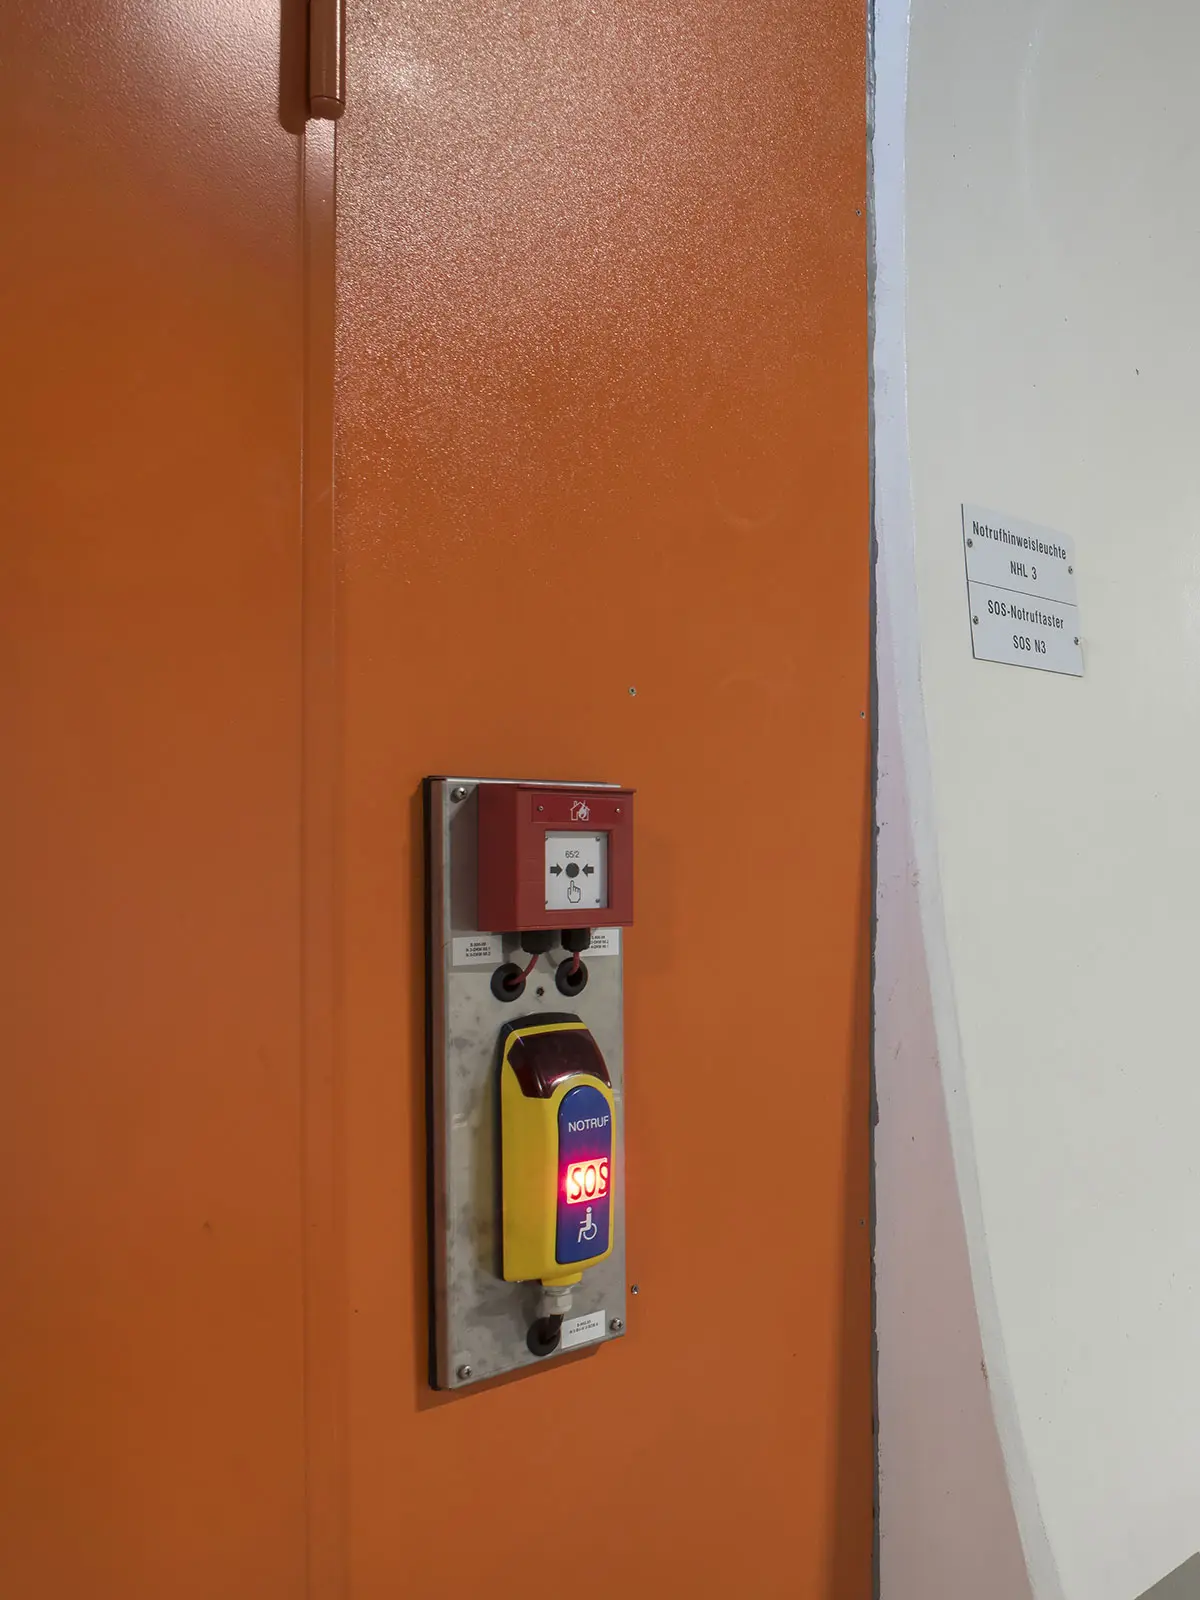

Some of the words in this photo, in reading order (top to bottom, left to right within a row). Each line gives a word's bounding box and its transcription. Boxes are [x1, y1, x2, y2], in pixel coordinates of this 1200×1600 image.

[972, 520, 1067, 560] Notrufhinweisleuchte
[1010, 561, 1028, 578] NHL
[1031, 566, 1037, 580] 3
[987, 600, 1064, 629] SOS-Notruftaster
[1013, 635, 1031, 651] SOS
[1035, 639, 1046, 654] N3
[568, 1115, 609, 1133] NOTRUF
[570, 1161, 608, 1200] SOS
